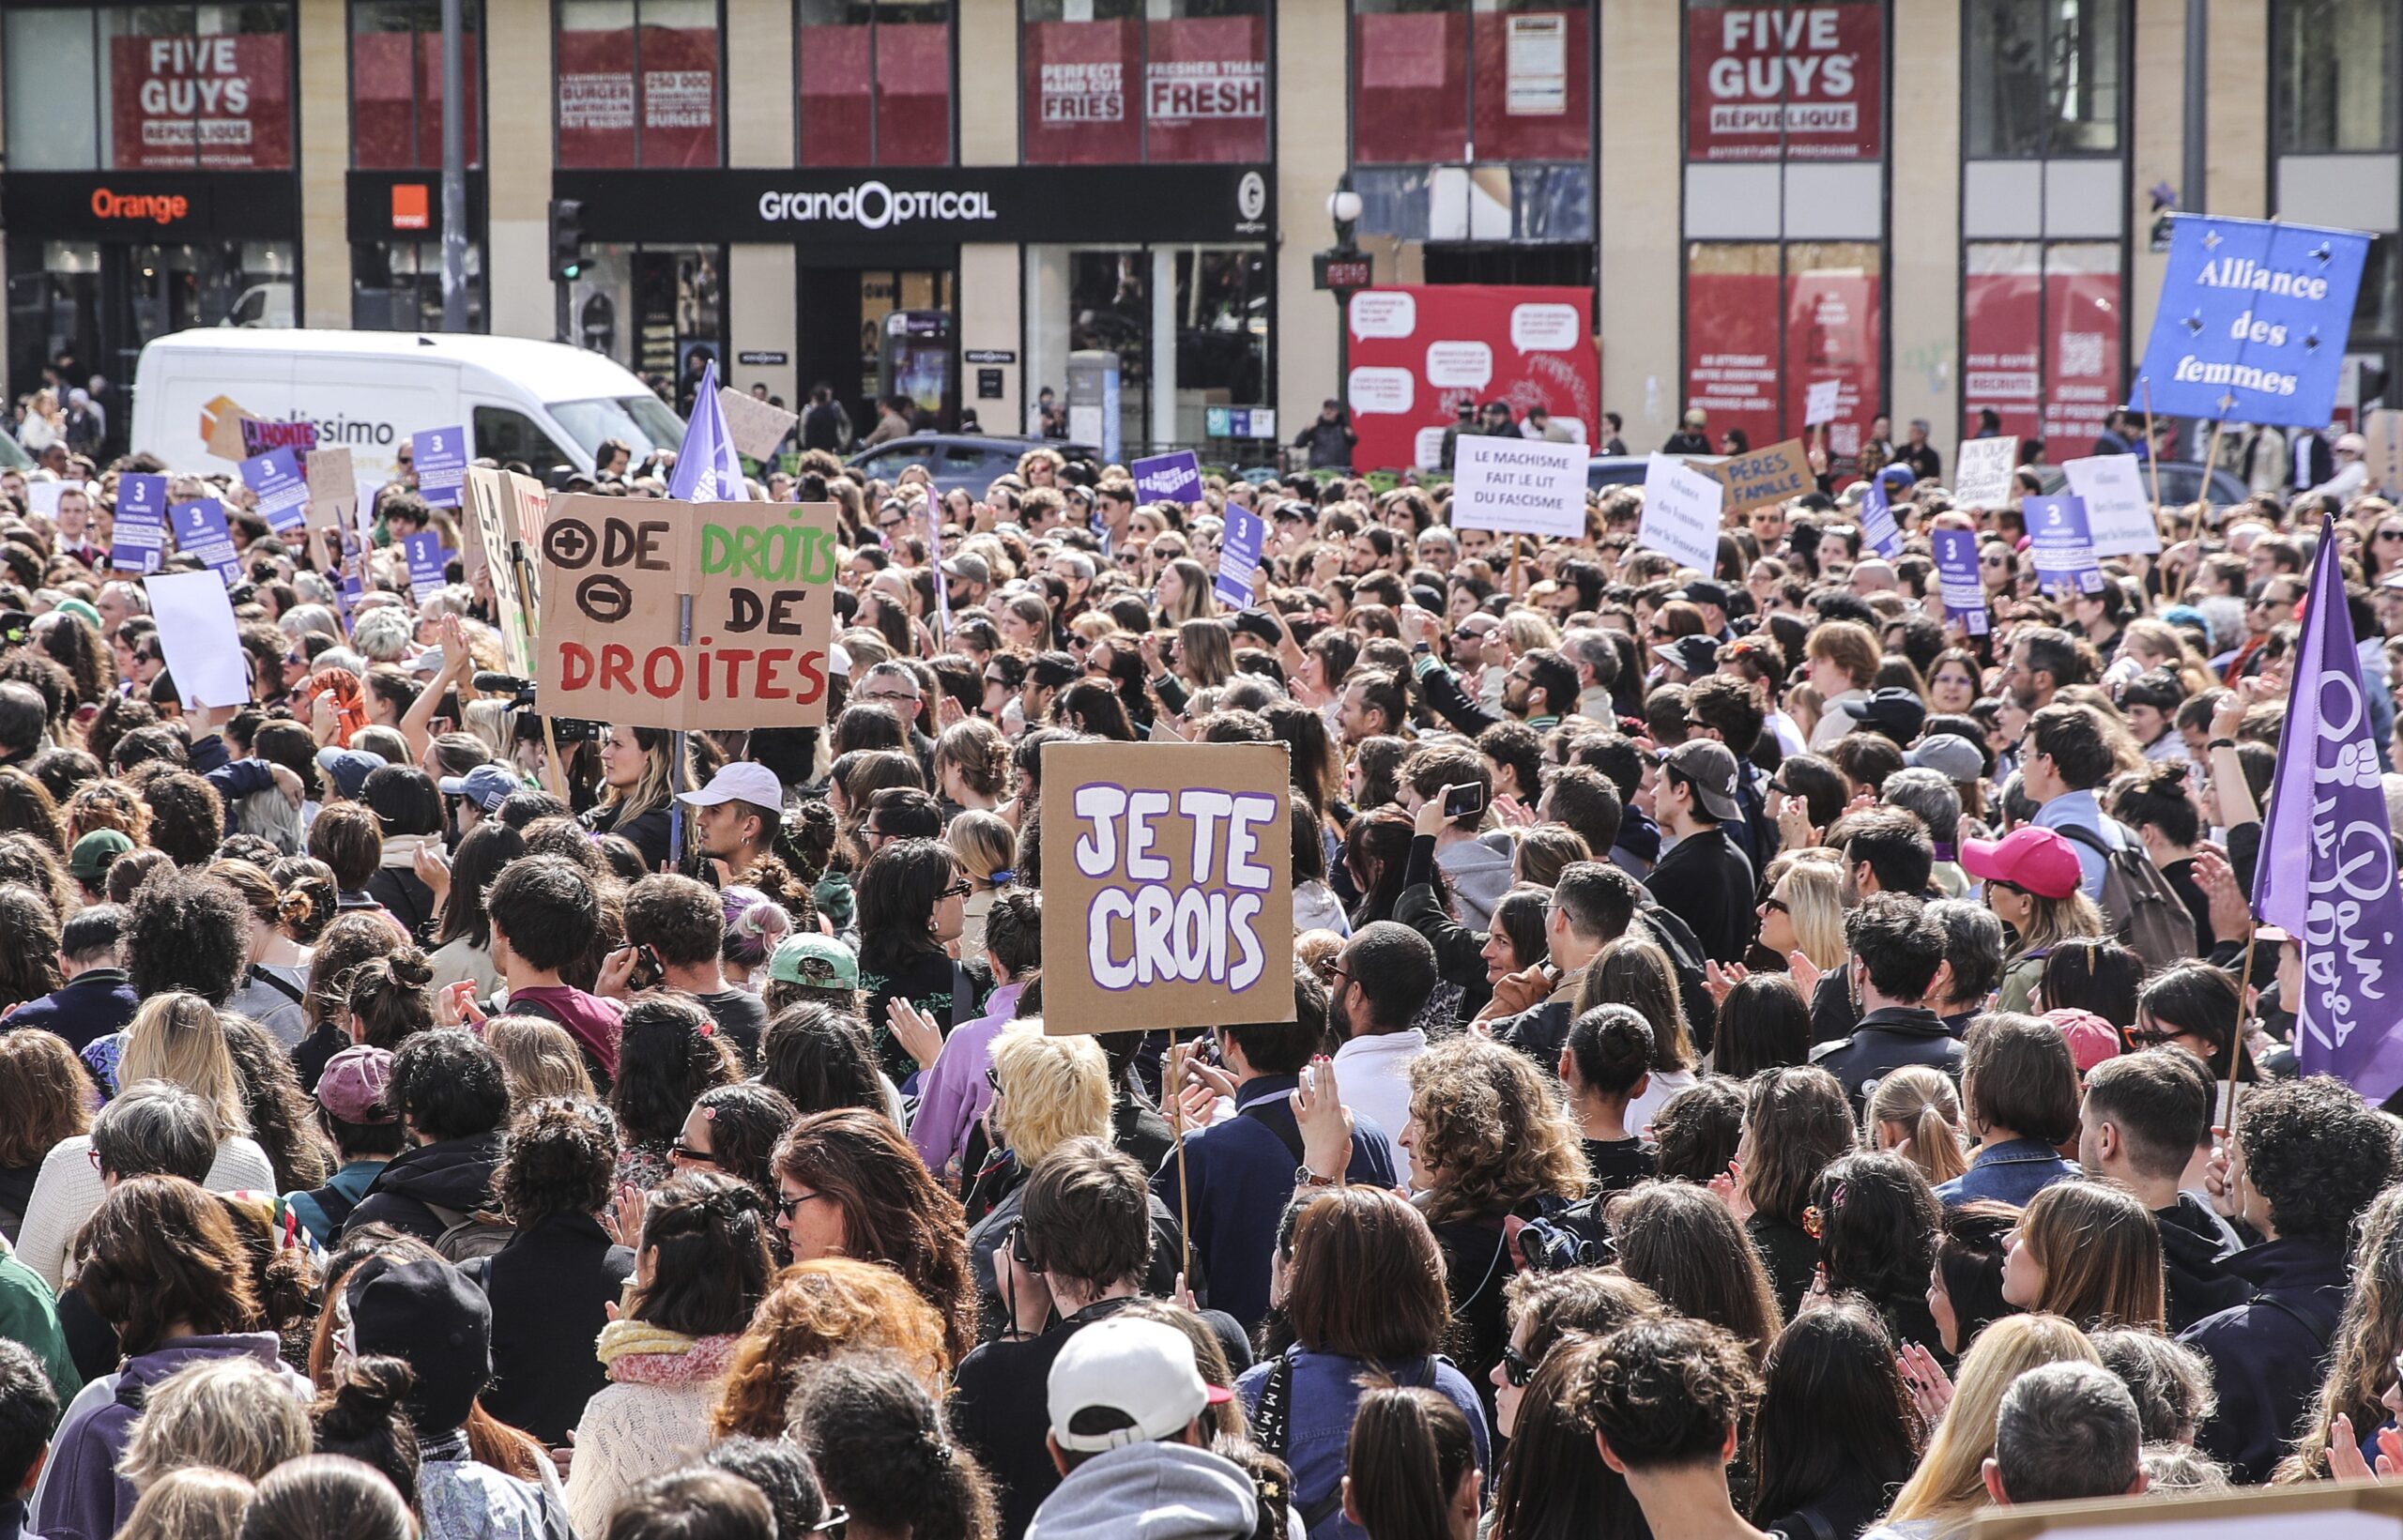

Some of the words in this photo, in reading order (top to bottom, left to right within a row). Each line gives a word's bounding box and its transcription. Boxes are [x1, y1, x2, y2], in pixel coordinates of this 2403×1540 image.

[1723, 9, 1840, 51] FIVE
[151, 38, 238, 74] FIVE
[1042, 63, 1123, 79] PERFECT
[1147, 62, 1217, 76] FRESHER
[1223, 61, 1265, 75] THAN
[1708, 53, 1855, 99] GUYS
[140, 78, 249, 114] GUYS
[1041, 79, 1087, 93] HAND
[1091, 78, 1122, 93] CUT
[1045, 97, 1120, 117] FRIES
[1152, 81, 1262, 114] FRESH
[646, 114, 712, 127] BURGER
[91, 189, 187, 223] Orange
[2196, 257, 2328, 300] Alliance
[2230, 311, 2288, 347] des
[1967, 354, 1997, 367] FIVE
[2000, 354, 2037, 368] GUYS
[1972, 378, 2032, 390] RECRUTE
[2173, 355, 2298, 396] femmes
[2064, 404, 2114, 419] POSTU
[260, 422, 314, 448] HONTE
[432, 435, 443, 452] 3
[261, 459, 276, 477] 3
[1475, 450, 1489, 463] LE
[1493, 451, 1570, 469] MACHISME
[1486, 471, 1515, 485] FAIT
[1519, 474, 1532, 486] LE
[1536, 476, 1555, 488] LIT
[1733, 473, 1802, 504] FAMILLE
[133, 481, 145, 502] 3
[1475, 491, 1494, 504] DU
[1498, 493, 1565, 510] FASCISME
[190, 507, 205, 526] 3
[2046, 504, 2061, 526] 3
[1238, 518, 1248, 539] 3
[415, 541, 426, 561] 3
[602, 517, 671, 571] DE
[1945, 538, 1957, 560] 3
[724, 587, 807, 635] DE
[1074, 782, 1171, 884] JE
[1178, 786, 1278, 892] TE
[2309, 819, 2393, 1000] Pain
[1085, 884, 1266, 995] CROIS
